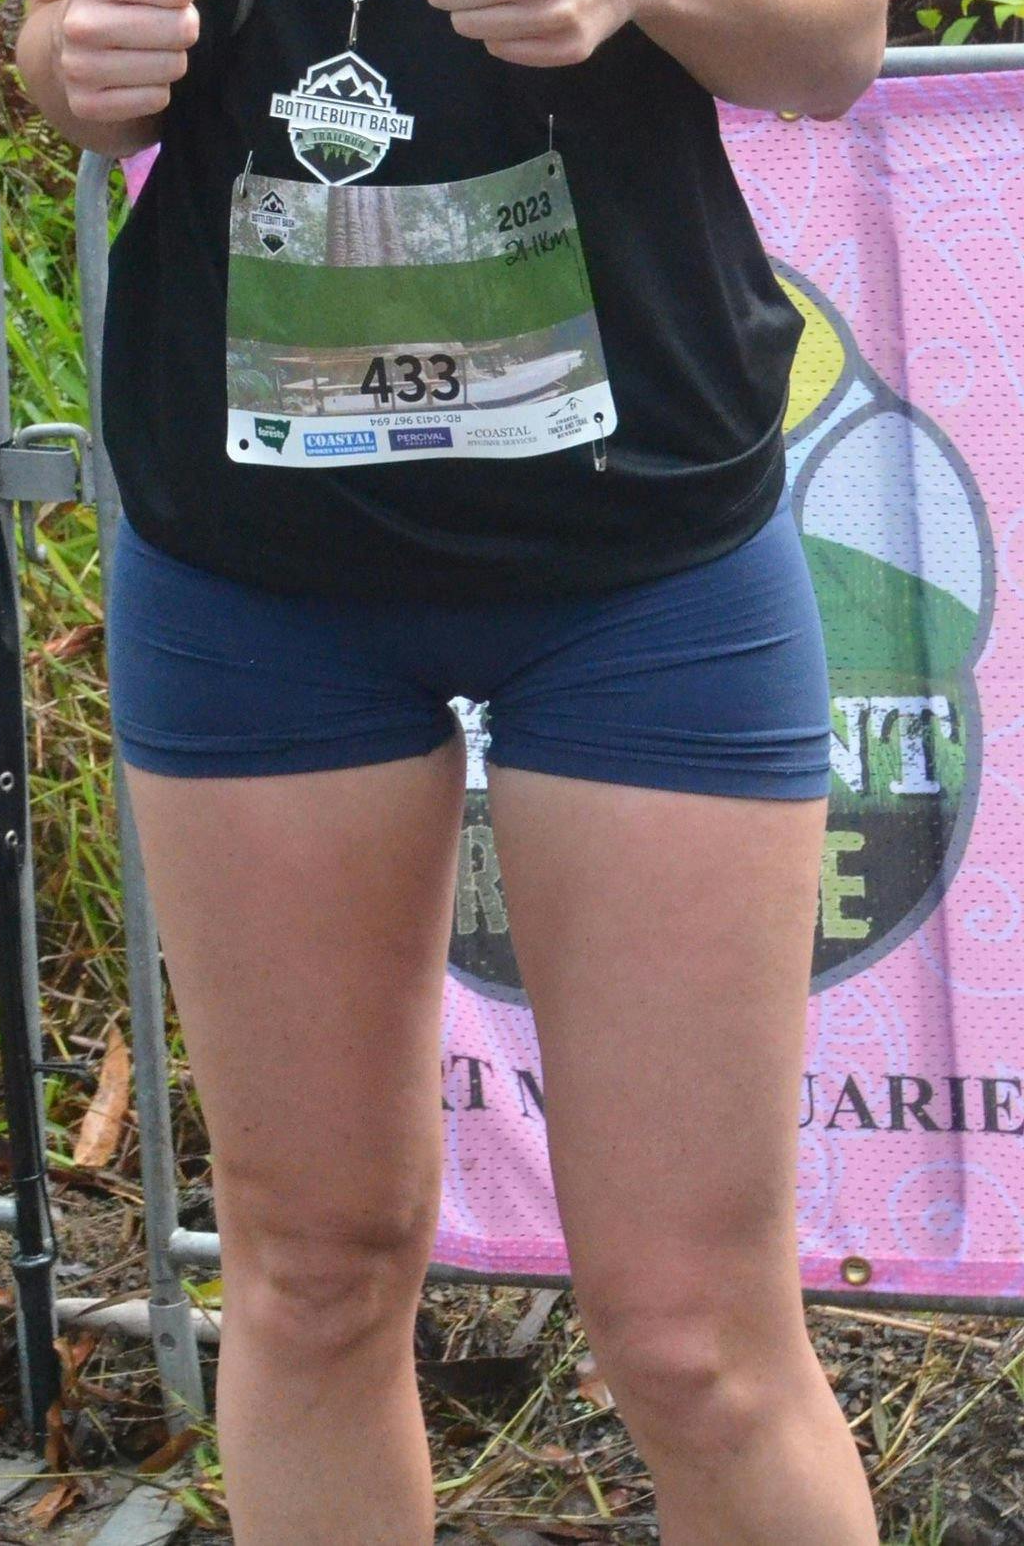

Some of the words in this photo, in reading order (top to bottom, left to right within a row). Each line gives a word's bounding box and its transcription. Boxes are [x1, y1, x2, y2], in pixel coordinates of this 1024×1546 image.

[276, 98, 367, 127] BOTTLEBUTT
[370, 116, 409, 136] BASH
[497, 191, 552, 233] 2023
[360, 354, 460, 403] 433
[370, 417, 390, 427] 694
[394, 416, 413, 426] 967
[416, 415, 441, 425] 0413
[443, 414, 461, 423] RD:
[396, 432, 446, 442] PERCIVAL
[475, 426, 531, 438] COASTAL
[306, 433, 375, 447] COASTAL
